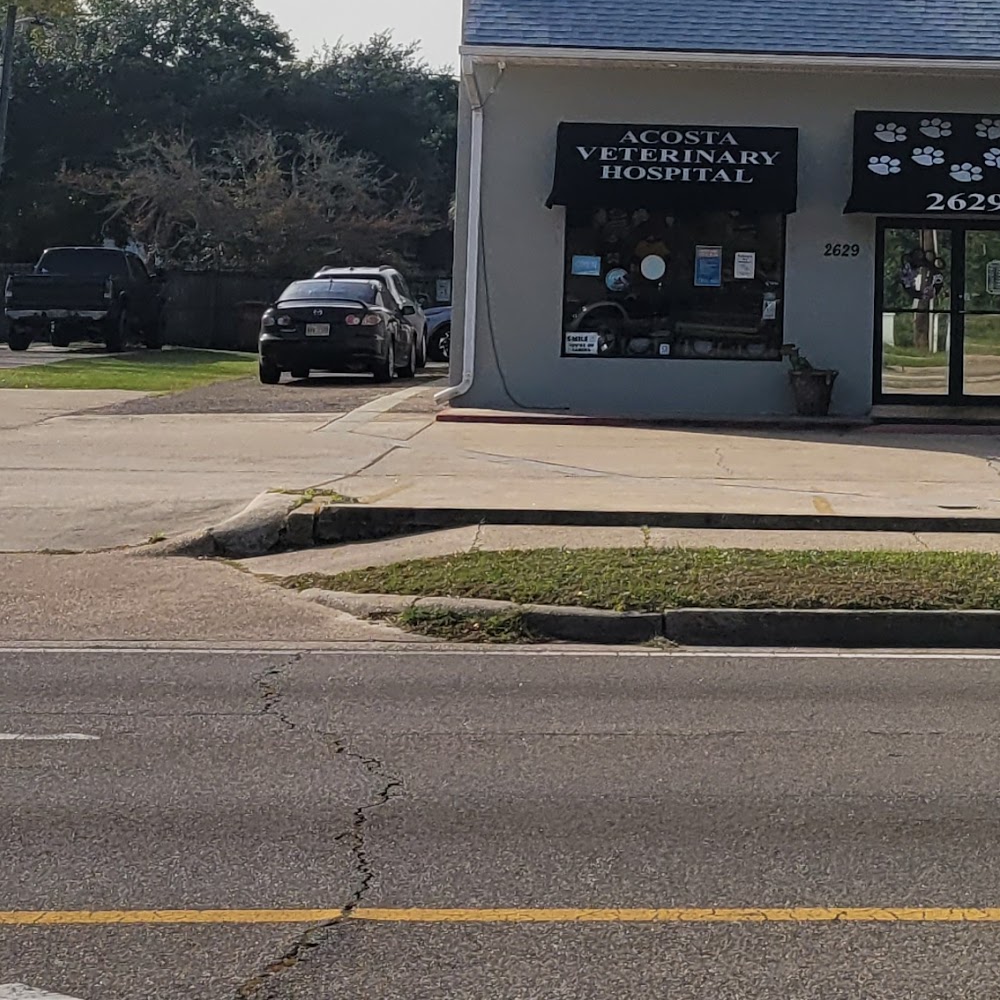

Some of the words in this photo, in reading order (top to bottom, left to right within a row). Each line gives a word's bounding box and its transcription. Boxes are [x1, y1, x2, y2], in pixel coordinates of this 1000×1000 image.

[619, 129, 740, 146] ACOSTA
[575, 145, 782, 166] VETERINARY
[599, 165, 754, 184] HOSPITAL
[823, 243, 860, 257] 2629
